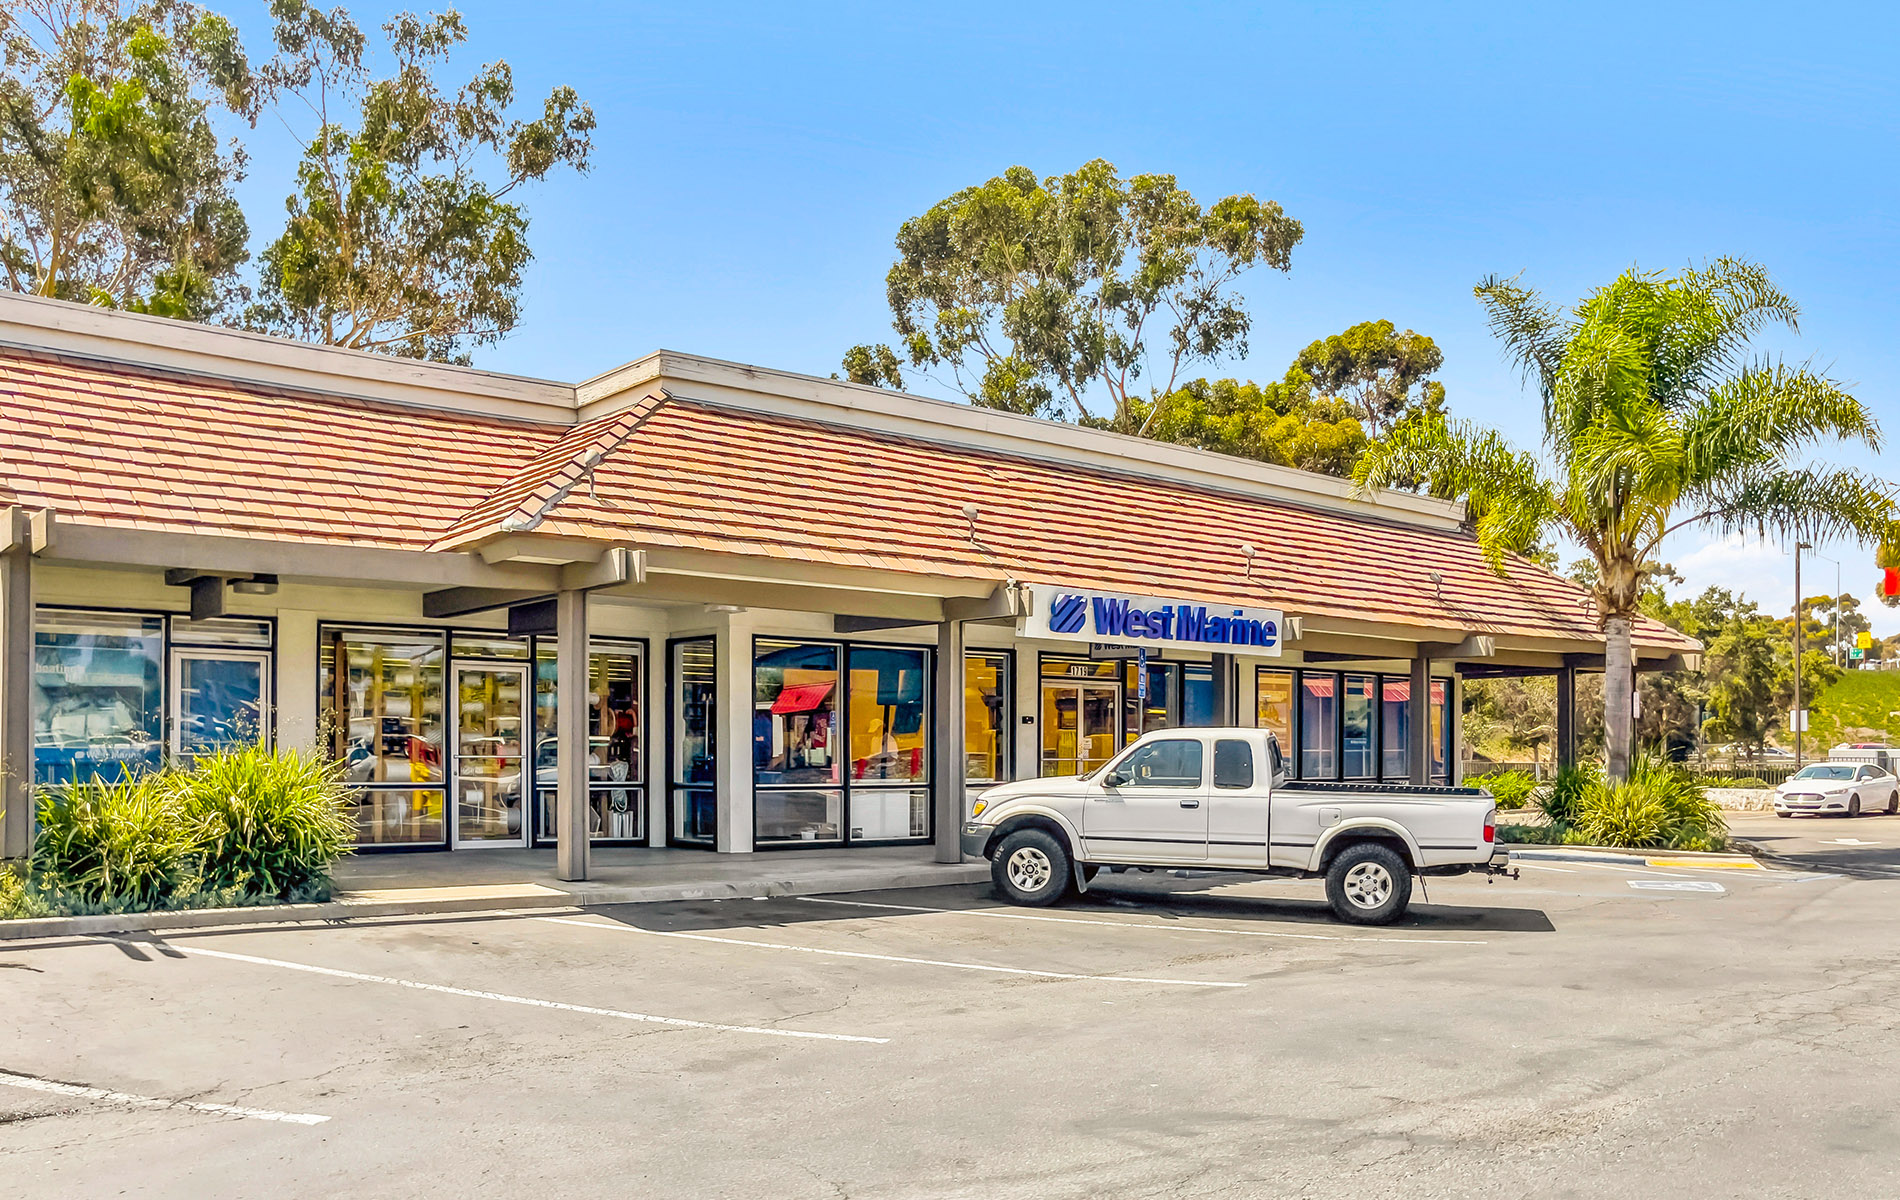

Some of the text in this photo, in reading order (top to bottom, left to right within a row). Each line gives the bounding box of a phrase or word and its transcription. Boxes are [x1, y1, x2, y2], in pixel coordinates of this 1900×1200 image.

[1093, 597, 1277, 647] West Marine
[1072, 666, 1087, 676] 1719
